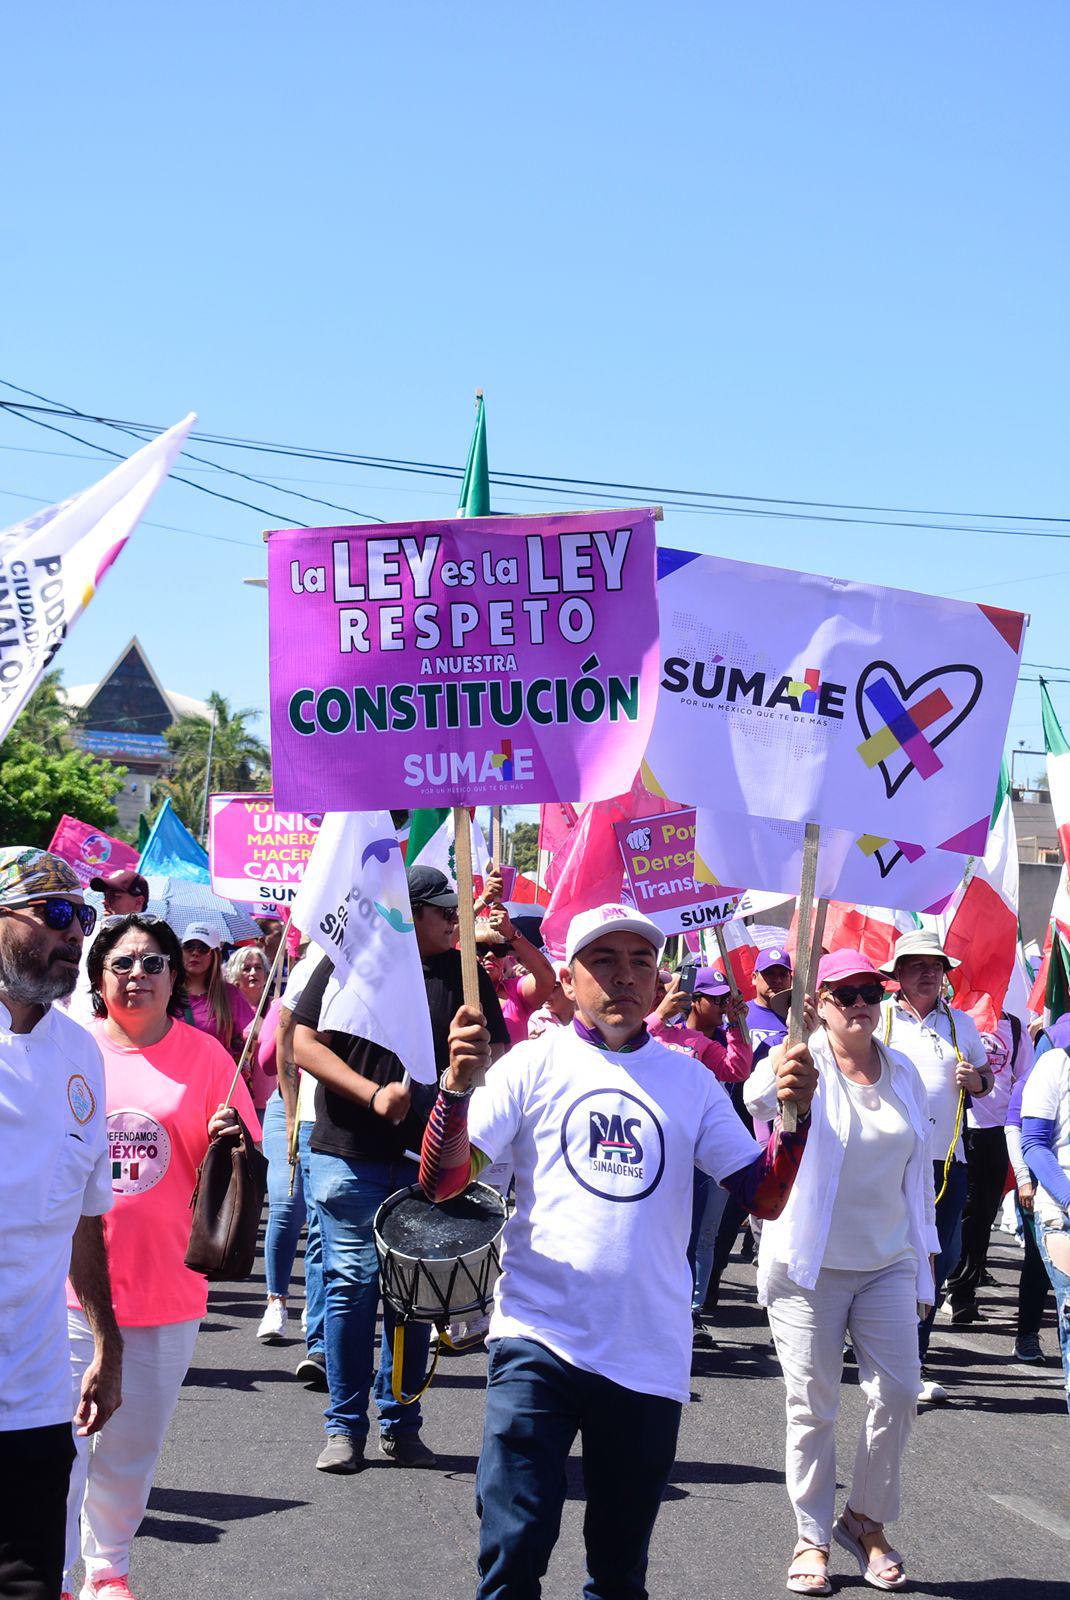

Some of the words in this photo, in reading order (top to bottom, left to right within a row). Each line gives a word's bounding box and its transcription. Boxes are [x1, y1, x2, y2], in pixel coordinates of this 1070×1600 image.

[290, 560, 326, 594] la
[332, 535, 442, 603] LEY
[440, 558, 476, 586] es
[482, 551, 519, 585] la
[526, 529, 632, 594] LEY
[338, 597, 595, 653] RESPETO
[420, 656, 433, 675] A
[436, 654, 518, 674] NUESTRA
[289, 652, 640, 736] CONSTITUCIÓN
[680, 697, 698, 707] POR
[702, 702, 714, 710] UN
[756, 710, 774, 719] QUE
[779, 713, 789, 721] TE
[793, 715, 805, 723] DE
[809, 717, 828, 727] MÁS
[421, 787, 433, 795] POR
[474, 784, 487, 792] QUE
[253, 813, 322, 832] UNIC
[243, 862, 304, 881] CAM
[632, 850, 696, 875] Derec
[634, 875, 706, 900] Transp
[107, 1131, 158, 1141] EFENDAMOS
[589, 1111, 644, 1165] PAS
[109, 1142, 158, 1159] ÉXICO
[593, 1160, 643, 1180] SINALOENSE
